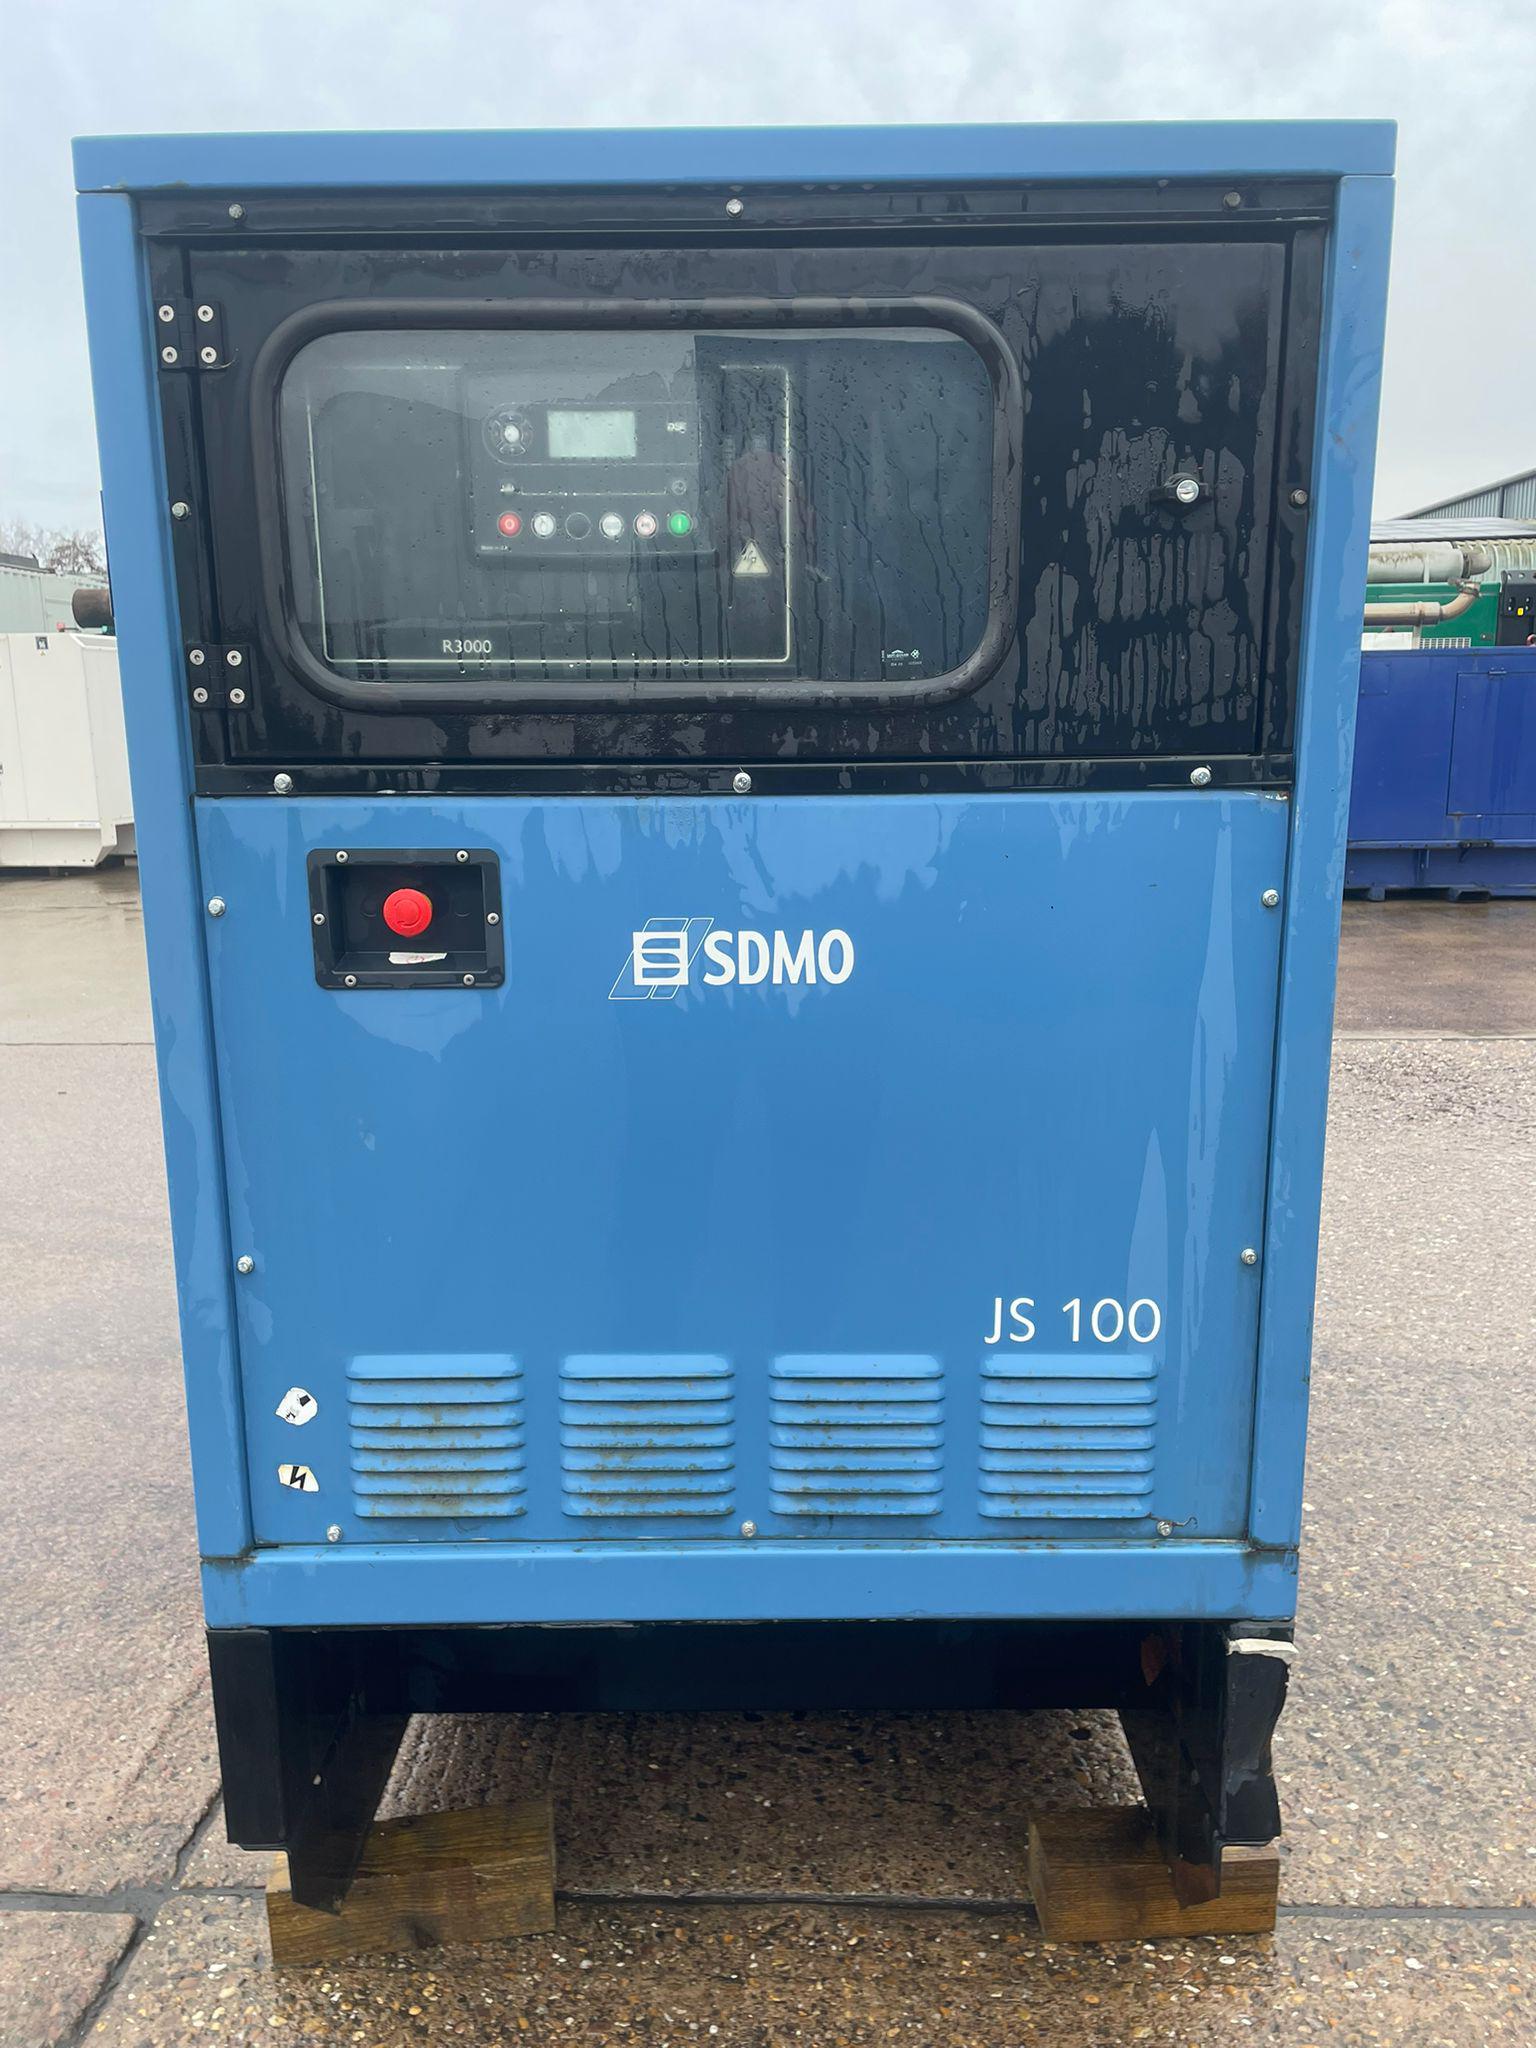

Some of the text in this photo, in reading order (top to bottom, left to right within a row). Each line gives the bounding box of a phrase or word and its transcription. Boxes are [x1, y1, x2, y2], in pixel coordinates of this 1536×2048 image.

[442, 639, 492, 653] R3000
[702, 928, 855, 985] SDMO
[983, 1296, 1161, 1344] JS 100
